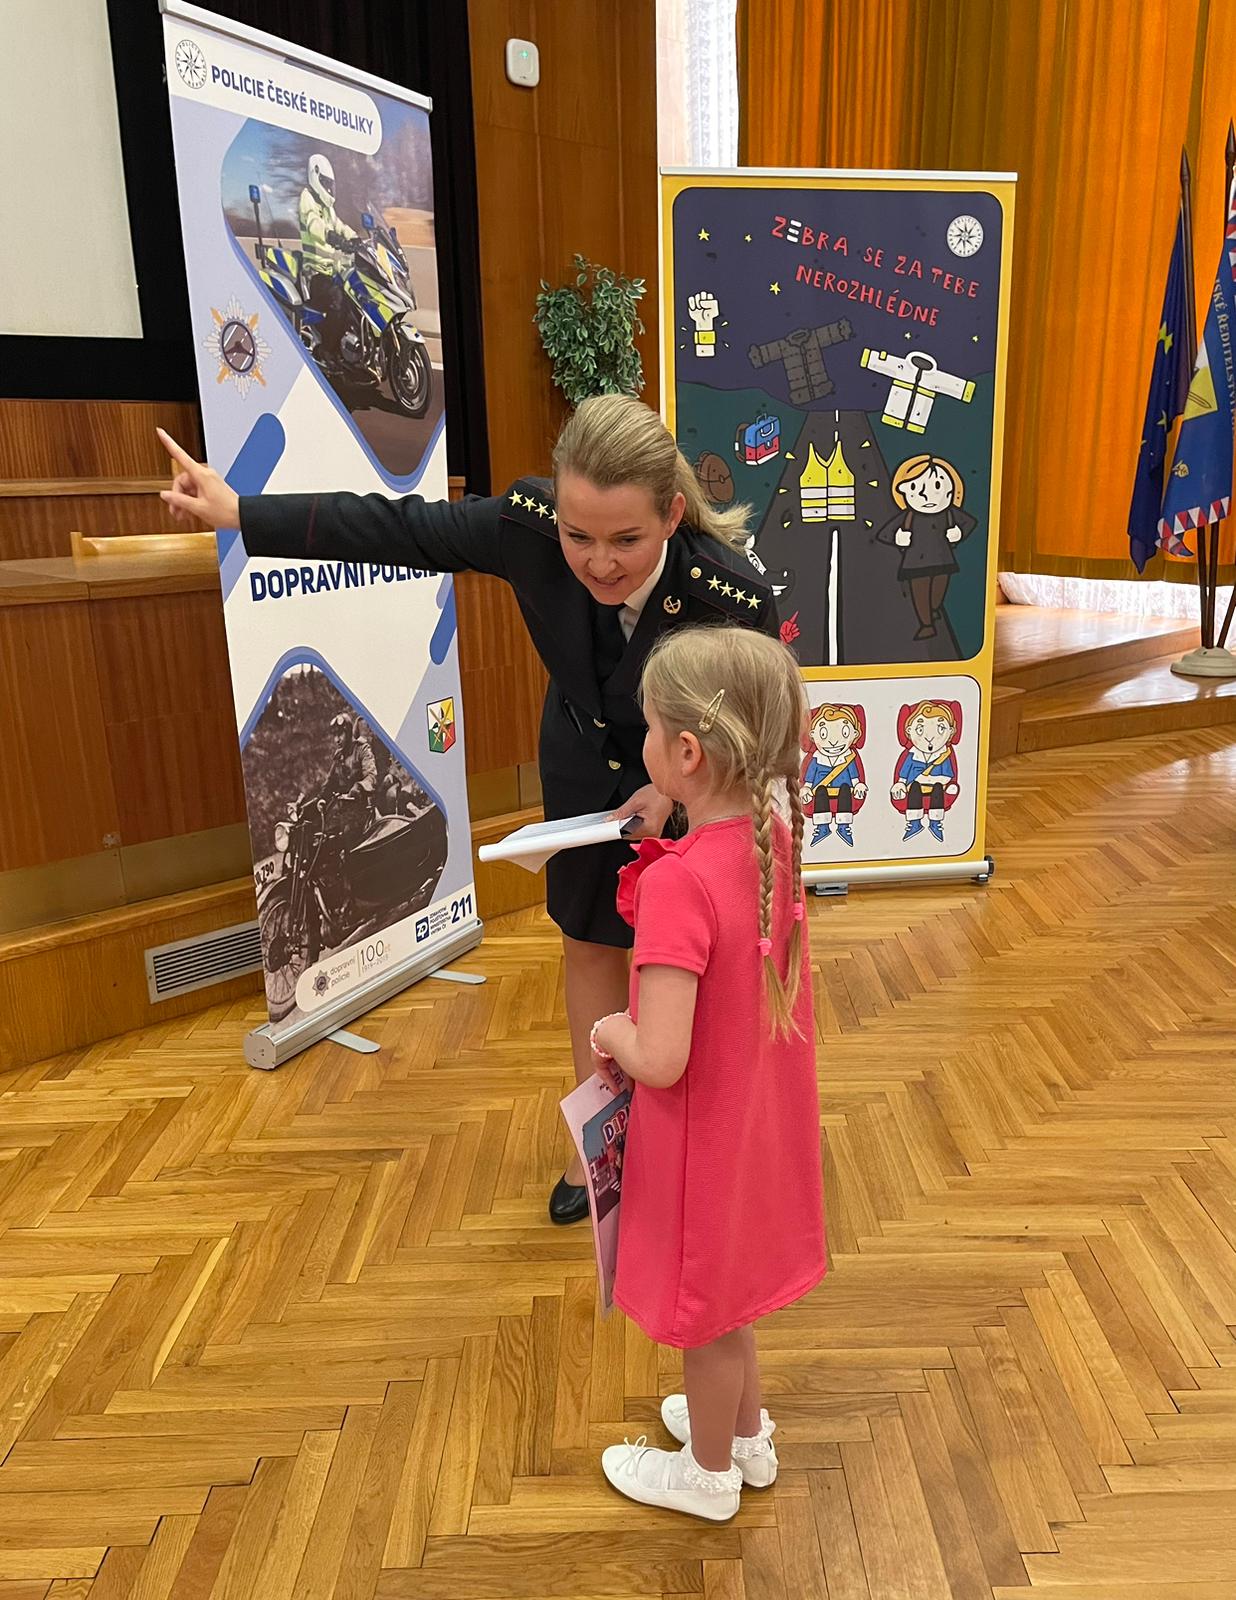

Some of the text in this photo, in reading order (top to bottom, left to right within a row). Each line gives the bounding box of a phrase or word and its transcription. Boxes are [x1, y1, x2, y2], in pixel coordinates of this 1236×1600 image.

[211, 65, 265, 99] POLICIE
[267, 79, 307, 113] ČESKÉ
[309, 98, 373, 135] REPUBLIKY
[771, 215, 980, 298] ZEBRA SE ZA TEBE
[795, 263, 941, 327] NEROZHLÉDNE
[450, 893, 472, 924] 211
[360, 939, 384, 966] 100
